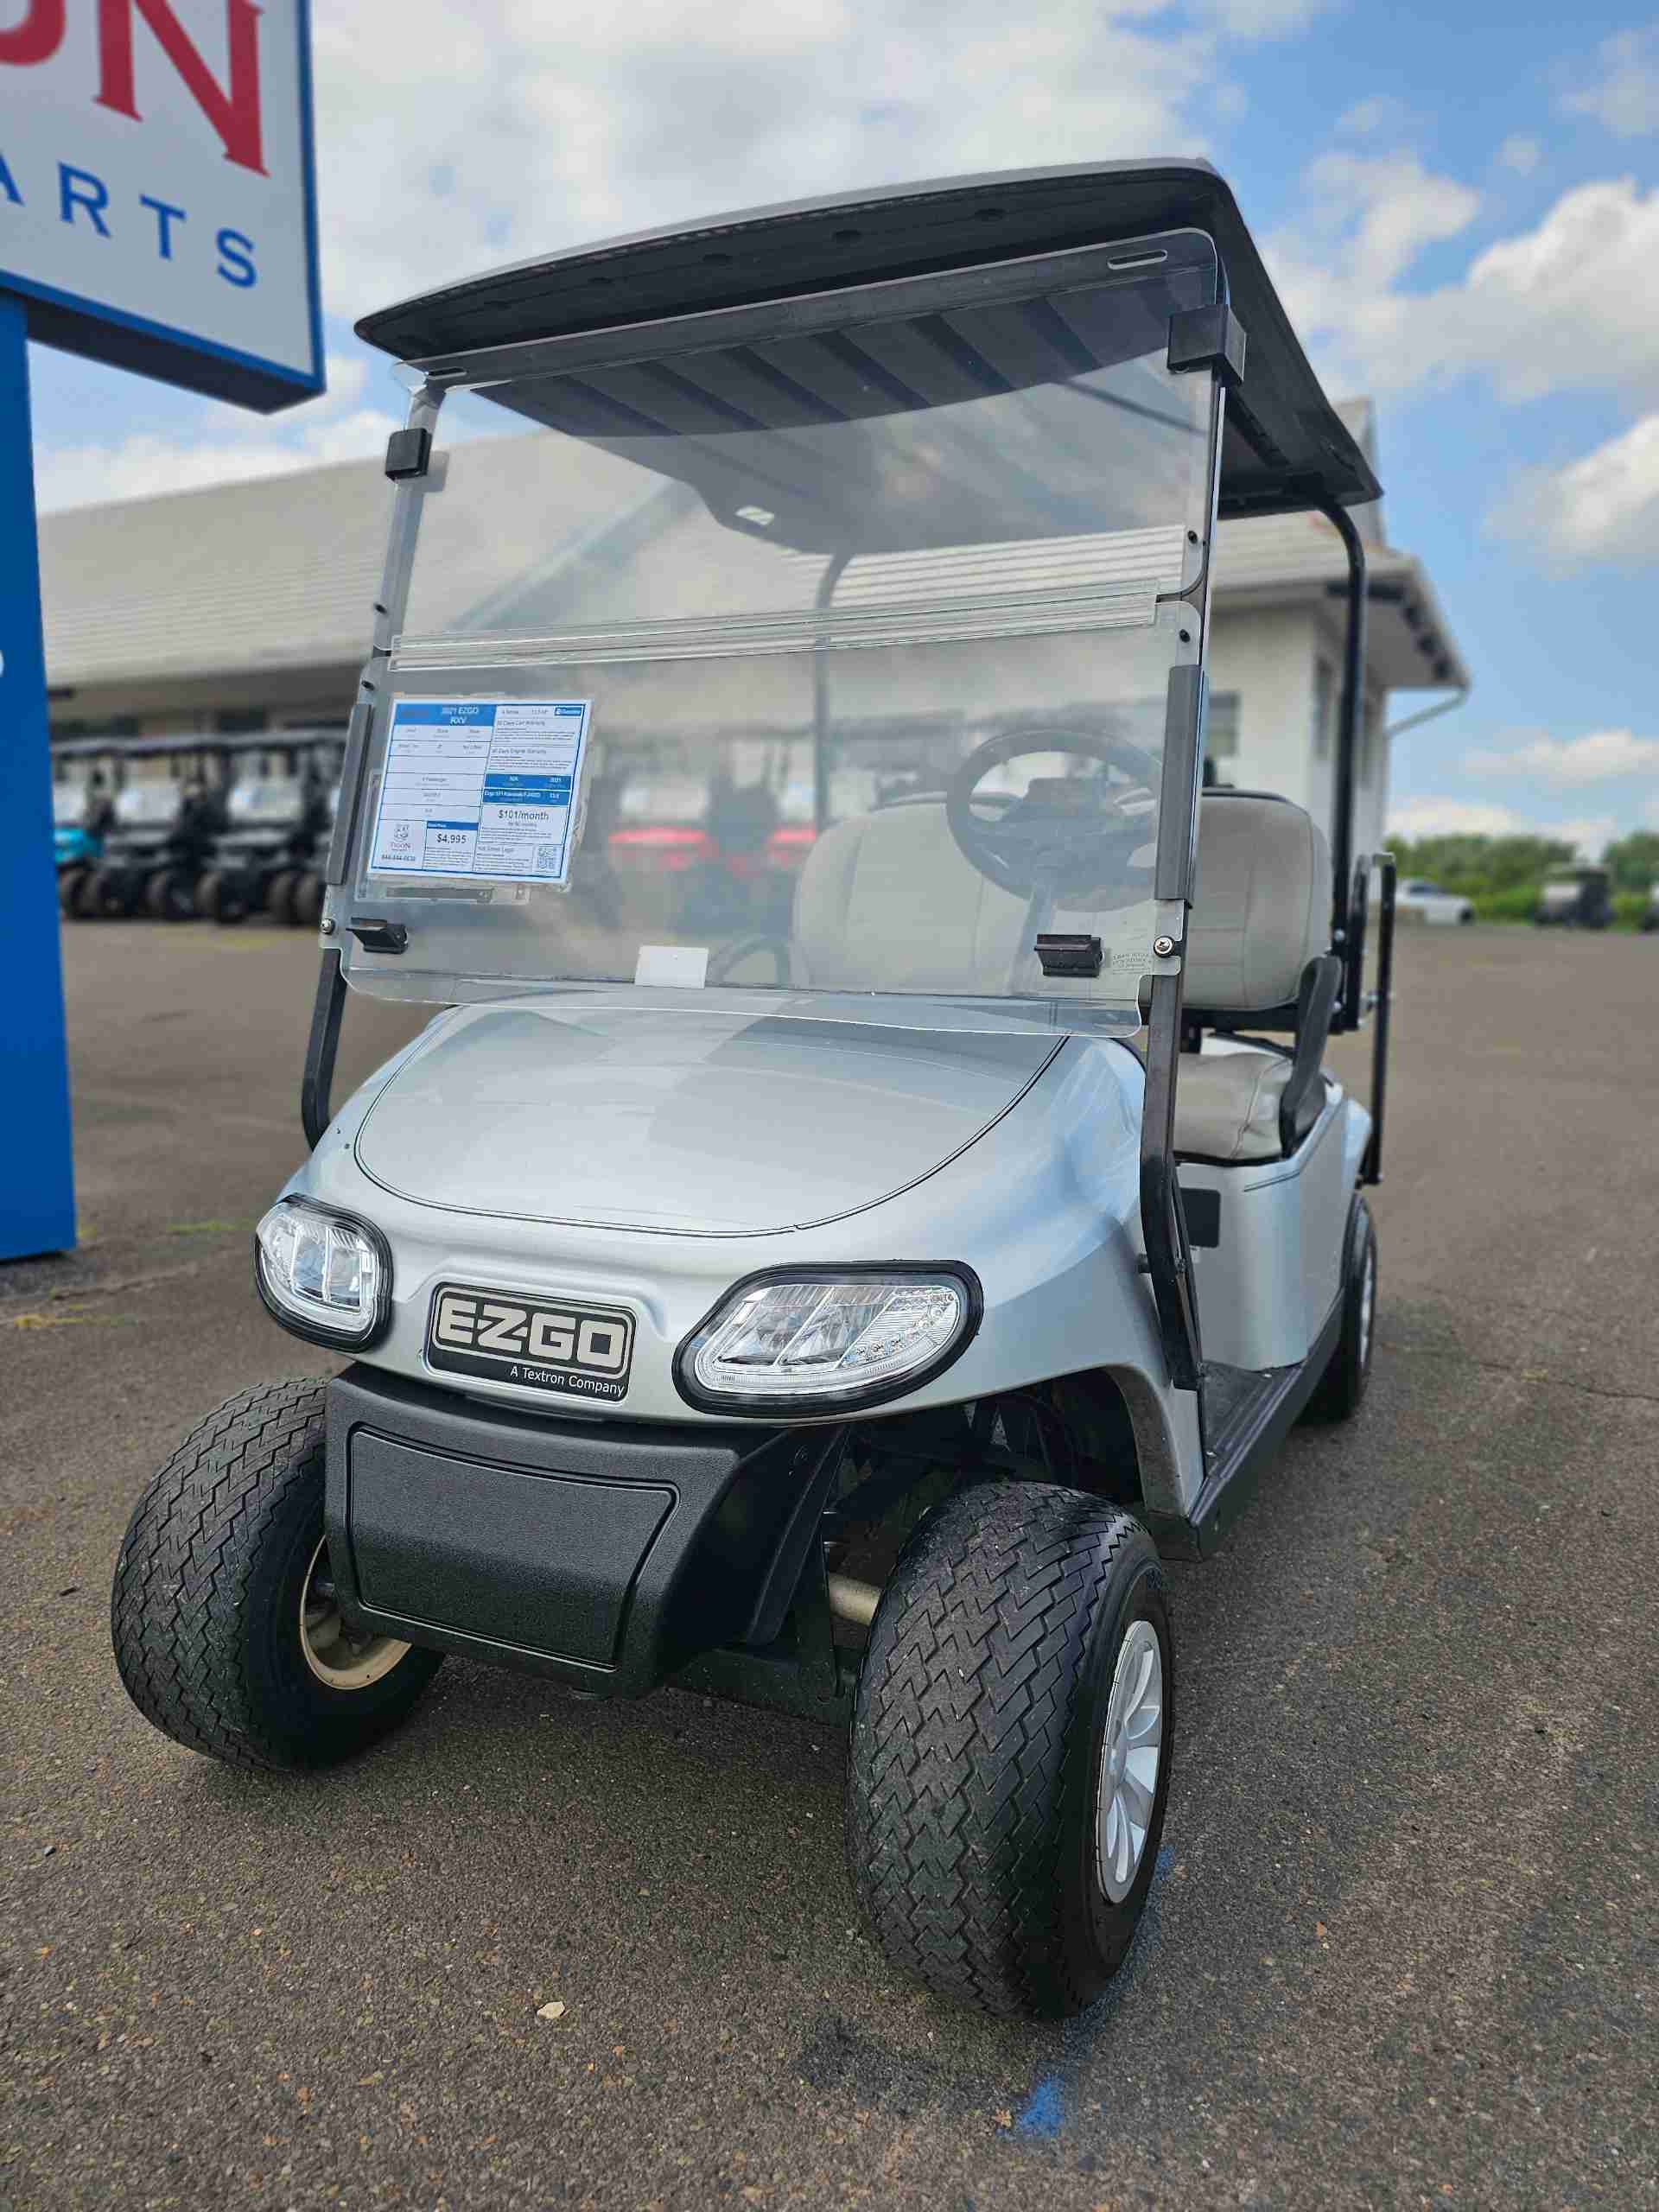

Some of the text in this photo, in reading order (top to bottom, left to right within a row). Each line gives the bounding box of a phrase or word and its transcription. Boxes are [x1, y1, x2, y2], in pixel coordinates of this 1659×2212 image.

[0, 0, 270, 178] N
[498, 809, 550, 821] $101/month
[436, 833, 467, 844] $4,995
[510, 1365, 625, 1397] A Textron Company
